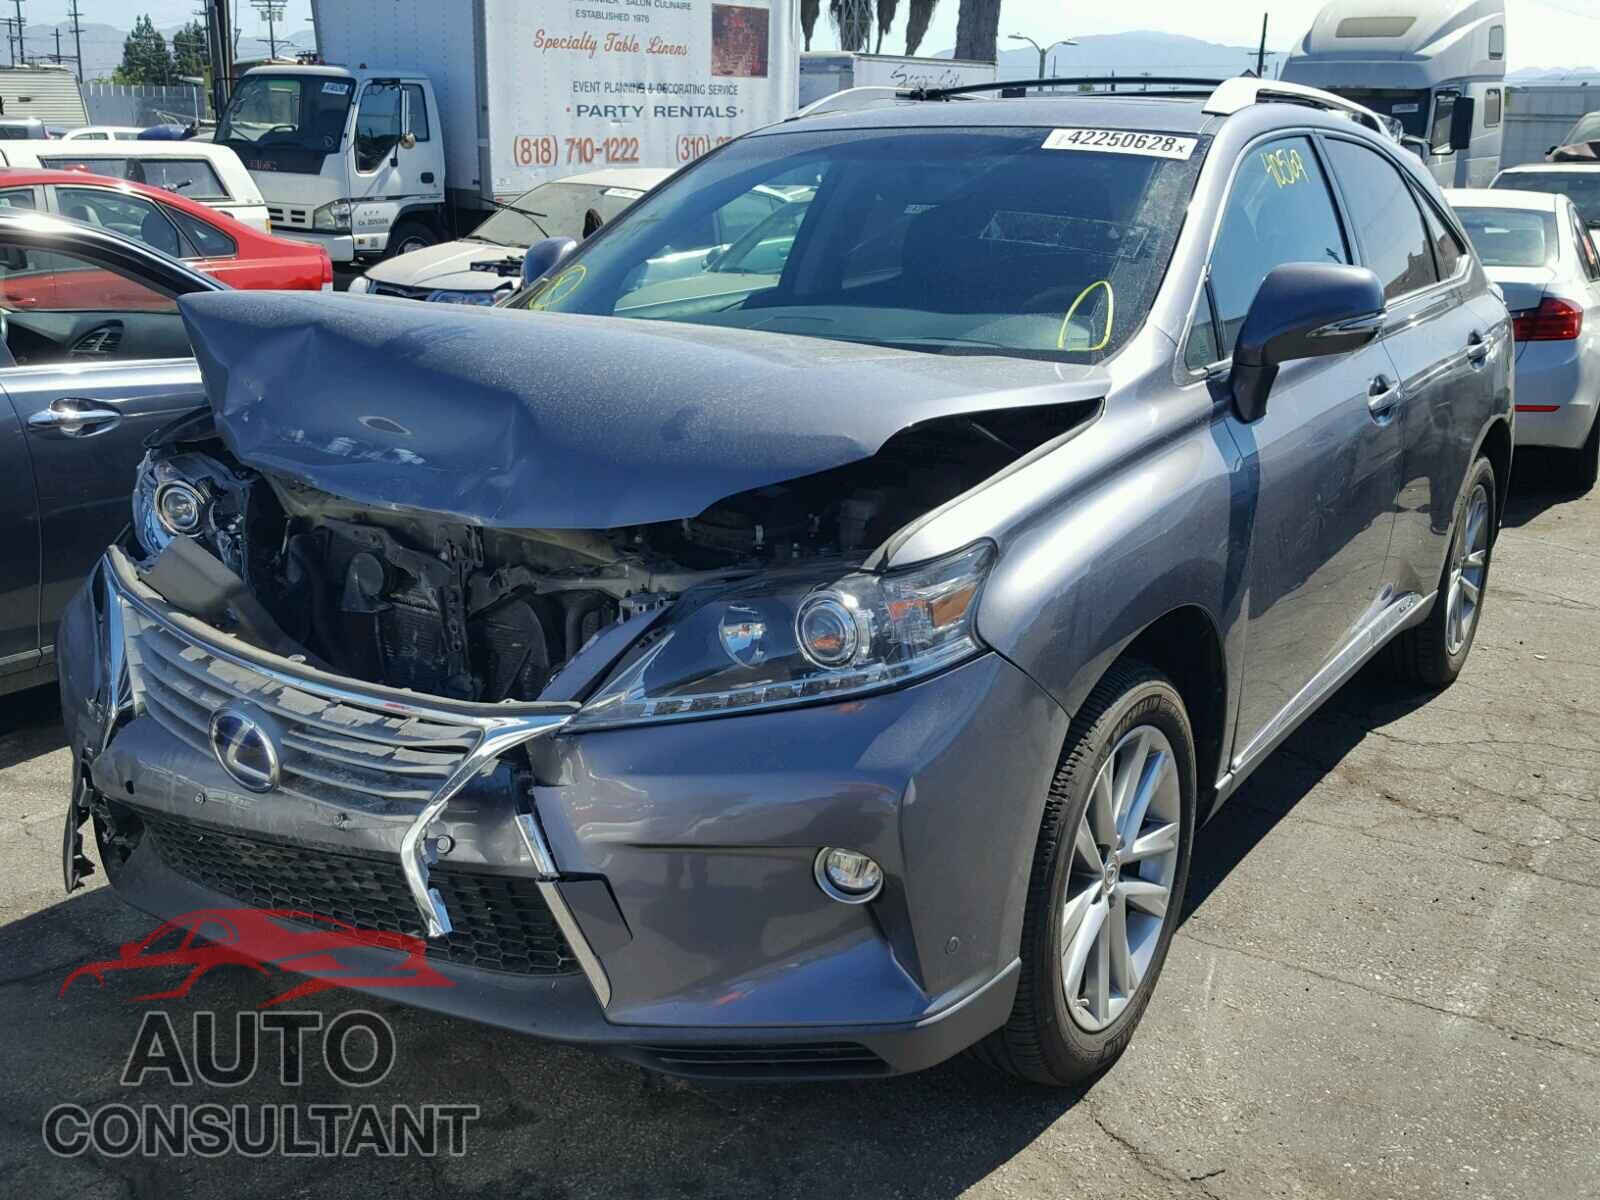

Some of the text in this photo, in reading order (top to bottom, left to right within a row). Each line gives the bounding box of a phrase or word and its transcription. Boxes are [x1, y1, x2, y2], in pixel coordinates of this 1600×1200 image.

[575, 9, 630, 21] ESTABLISHED
[533, 28, 688, 58] Specialty Table Linens
[572, 80, 601, 94] EVENT
[604, 81, 646, 95] PLANNING
[656, 83, 706, 96] DECORATING
[708, 84, 738, 96] SERVICE
[576, 104, 737, 119] PARTY RENTALS
[513, 134, 559, 167] (818)
[565, 136, 640, 165] 710-1222
